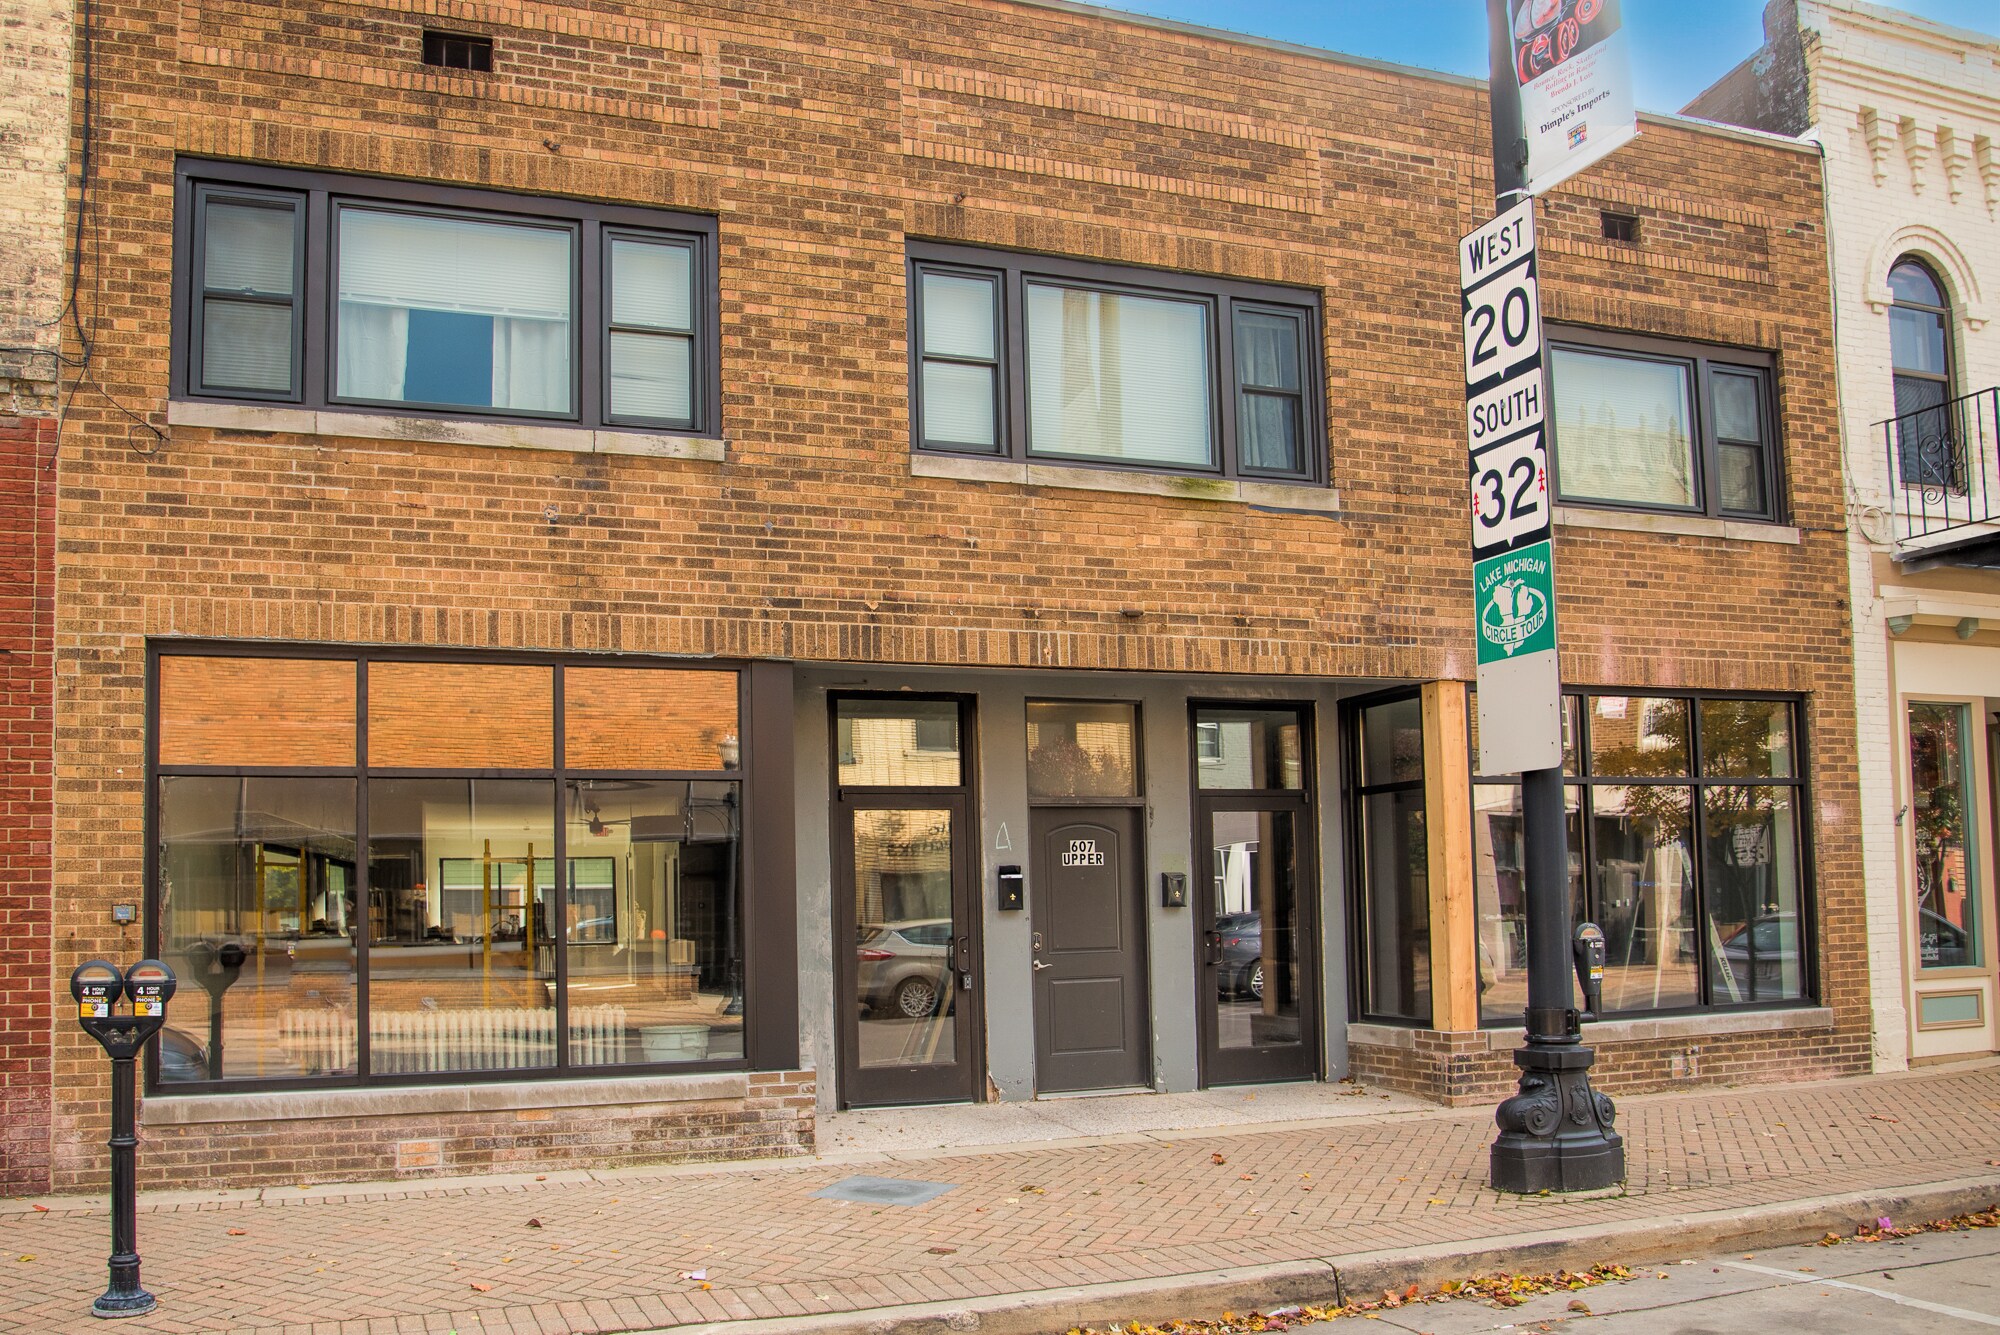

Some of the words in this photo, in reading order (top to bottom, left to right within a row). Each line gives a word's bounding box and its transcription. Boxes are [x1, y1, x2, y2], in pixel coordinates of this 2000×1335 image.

[1550, 82, 1572, 98] Brenda
[1551, 91, 1588, 114] SPONSORED
[1587, 87, 1595, 96] BY
[1540, 109, 1575, 134] Dimple's
[1576, 89, 1610, 113] Imports
[1468, 217, 1523, 274] WEST
[1470, 286, 1530, 367] 20
[1473, 384, 1538, 438] SOUTH
[1479, 456, 1538, 528] 32
[1479, 566, 1502, 593] LAKE
[1503, 557, 1546, 576] MICHIGAN
[1485, 625, 1517, 642] CIRCLE
[1520, 610, 1544, 637] TOUR
[1063, 853, 1103, 865] UPPER
[1071, 841, 1094, 853] 607
[82, 986, 90, 995] 4
[137, 986, 144, 995] 4
